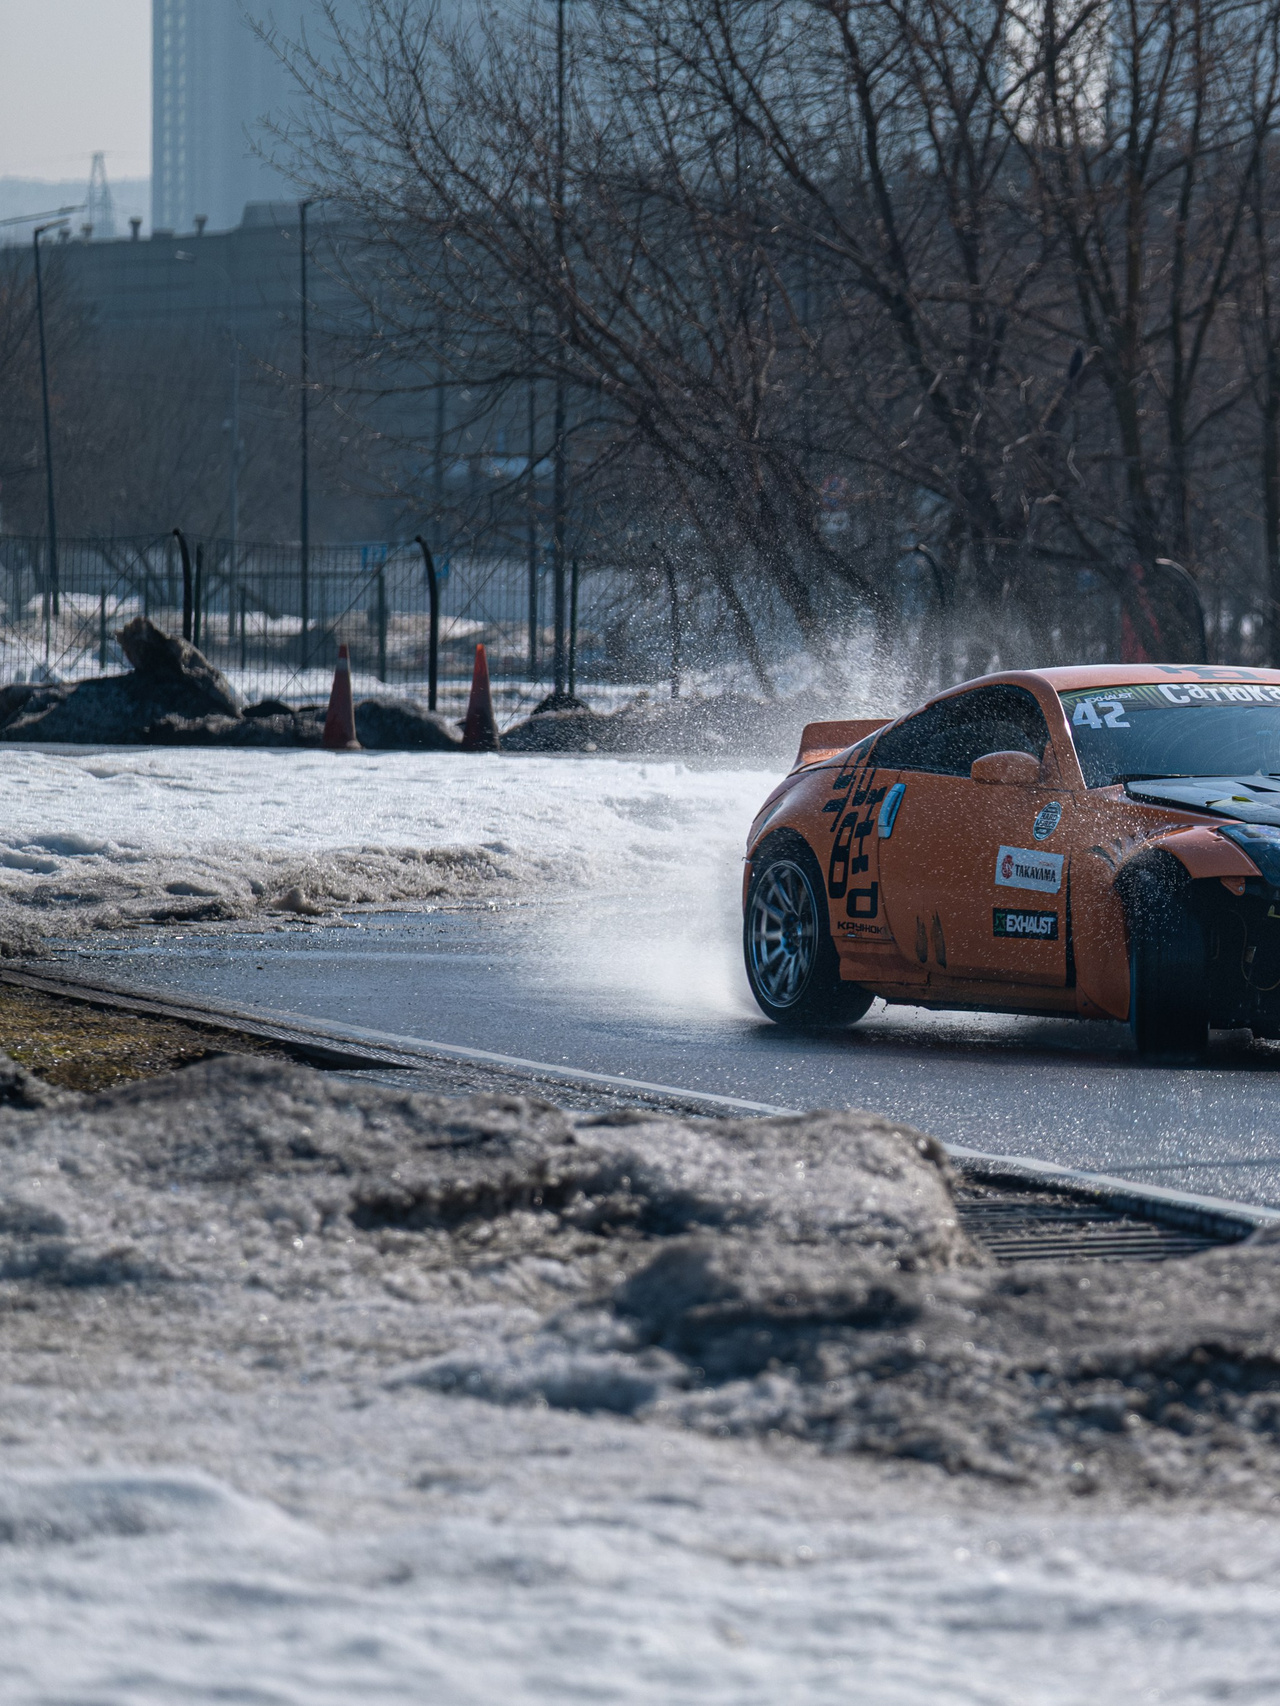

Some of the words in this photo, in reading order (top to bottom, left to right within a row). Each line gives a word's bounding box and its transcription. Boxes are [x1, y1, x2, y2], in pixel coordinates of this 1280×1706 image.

[1072, 701, 1131, 729] 42
[1015, 863, 1057, 882] TAKAYAMA
[1006, 914, 1056, 934] EXHAUST
